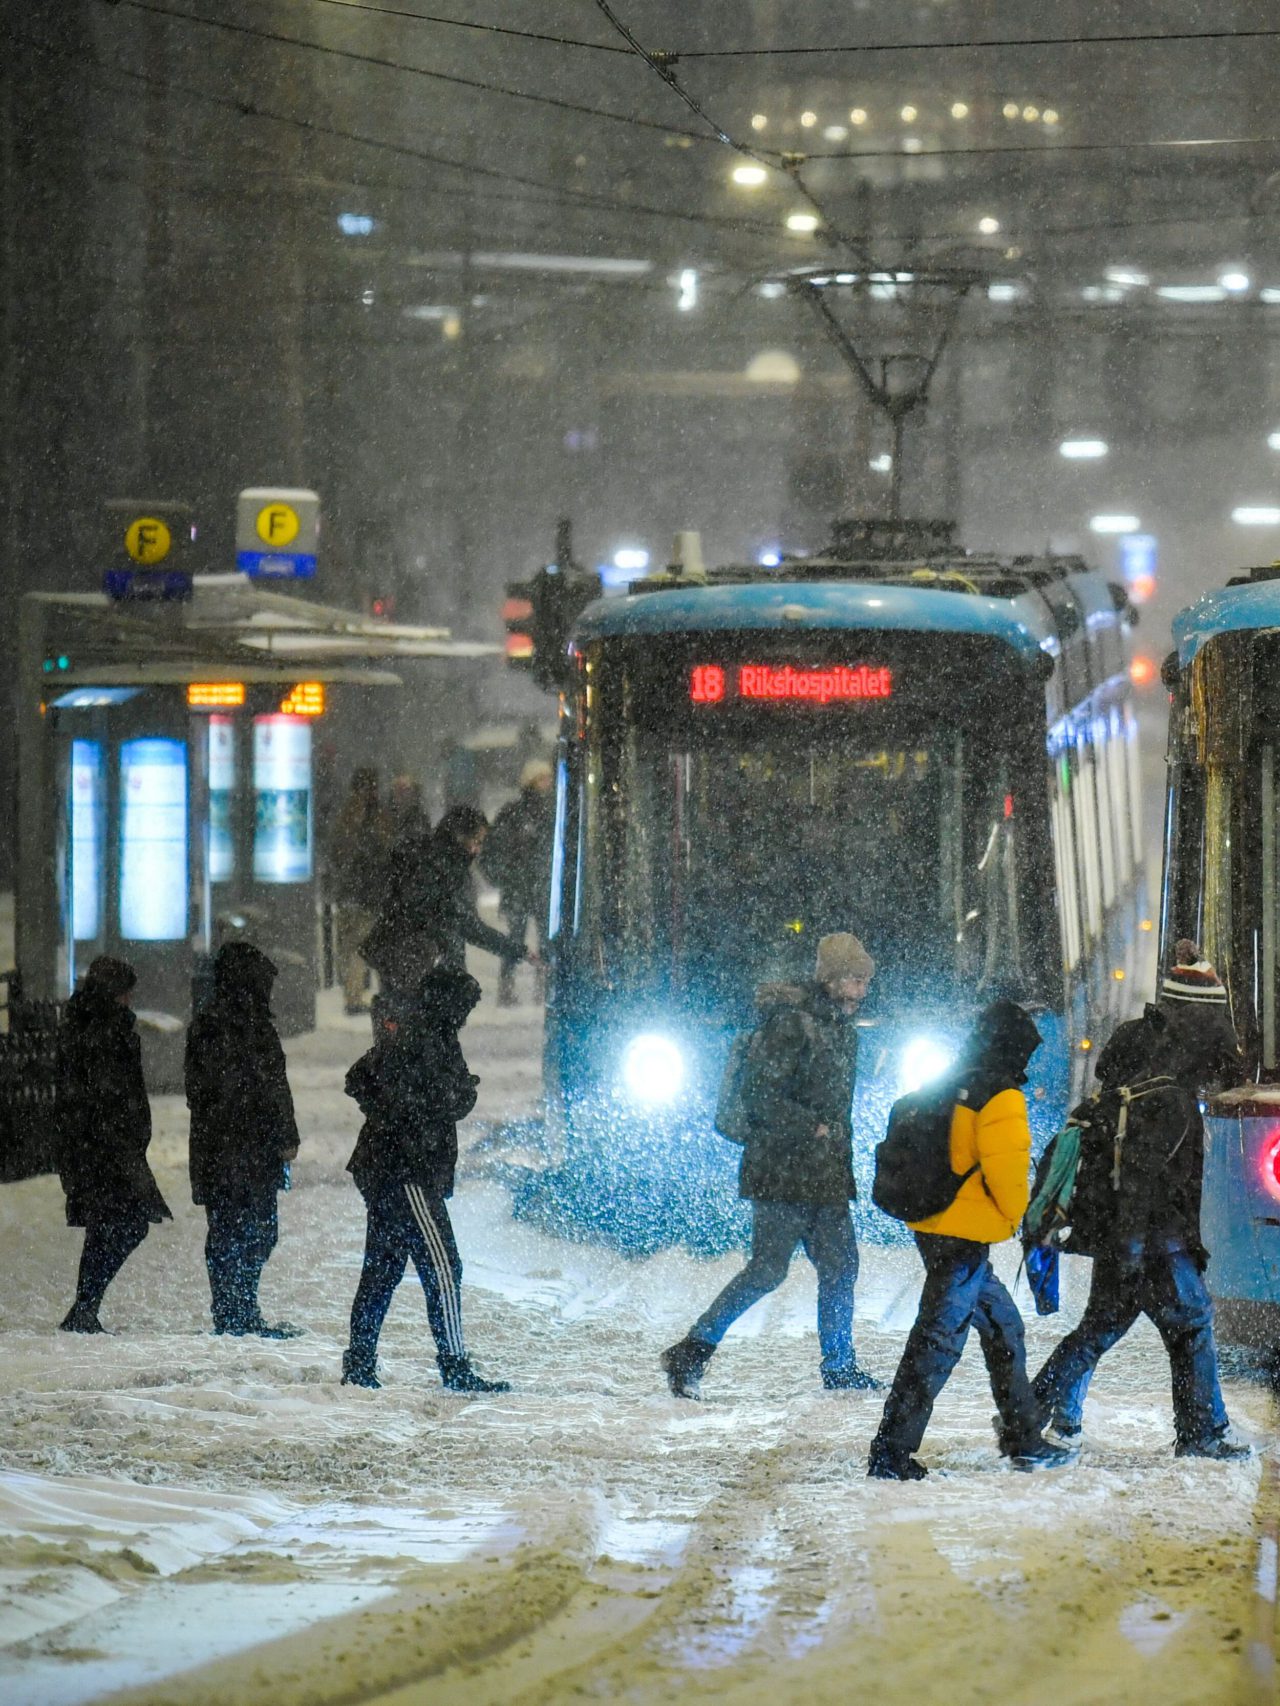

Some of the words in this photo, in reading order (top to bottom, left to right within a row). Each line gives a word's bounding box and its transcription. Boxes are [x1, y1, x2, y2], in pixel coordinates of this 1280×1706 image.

[268, 511, 287, 538] F
[138, 525, 158, 557] F
[691, 665, 723, 701] 18
[741, 665, 890, 703] Rikshospitalet
